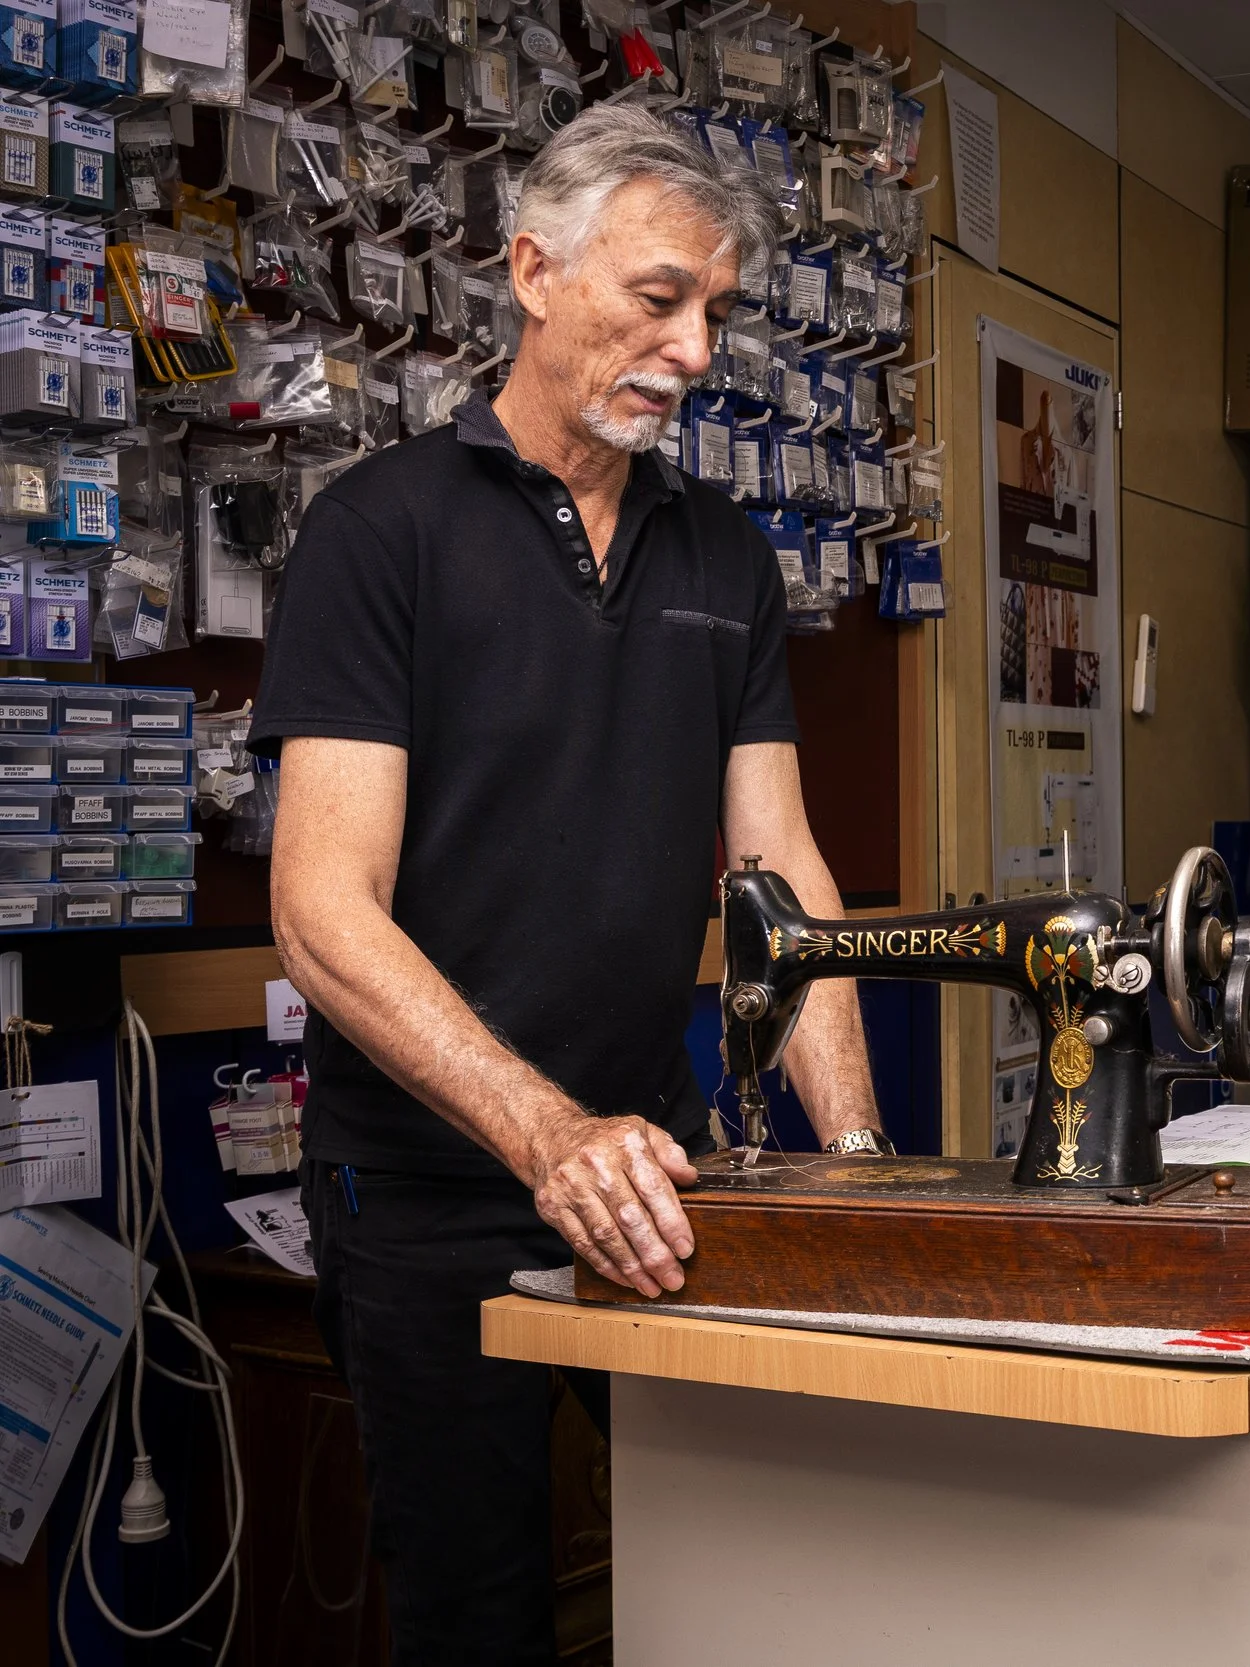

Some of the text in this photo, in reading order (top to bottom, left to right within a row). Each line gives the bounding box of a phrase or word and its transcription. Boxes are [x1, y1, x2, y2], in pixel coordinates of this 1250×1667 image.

[89, 0, 134, 20] SCHMETZ
[0, 105, 39, 118] SCHMETZ
[64, 121, 112, 138] SCHMETZ
[0, 221, 41, 236] CHMETZ
[55, 237, 101, 252] SCHMETZ
[797, 255, 815, 263] brother
[28, 328, 77, 344] SCHMETZ
[83, 343, 130, 356] SCHMETZ
[1065, 365, 1099, 391] JUKI
[705, 413, 721, 421] brother
[69, 458, 108, 468] SCHMETZ
[35, 577, 85, 588] SCHMETZ
[9, 708, 44, 717] BOBBINS
[70, 715, 89, 723] JANOME
[156, 720, 175, 728] BOBBINS
[1006, 729, 1034, 748] TL-98
[1037, 730, 1045, 749] P
[79, 800, 103, 808] PFAFF
[75, 812, 109, 821] BOBBINS
[837, 929, 951, 958] SINGER
[37, 1266, 53, 1281] Sewing
[52, 1275, 70, 1291] Machine
[70, 1287, 85, 1300] Needle
[12, 1290, 86, 1342] SCHMETZ NEEDLE GUIDE
